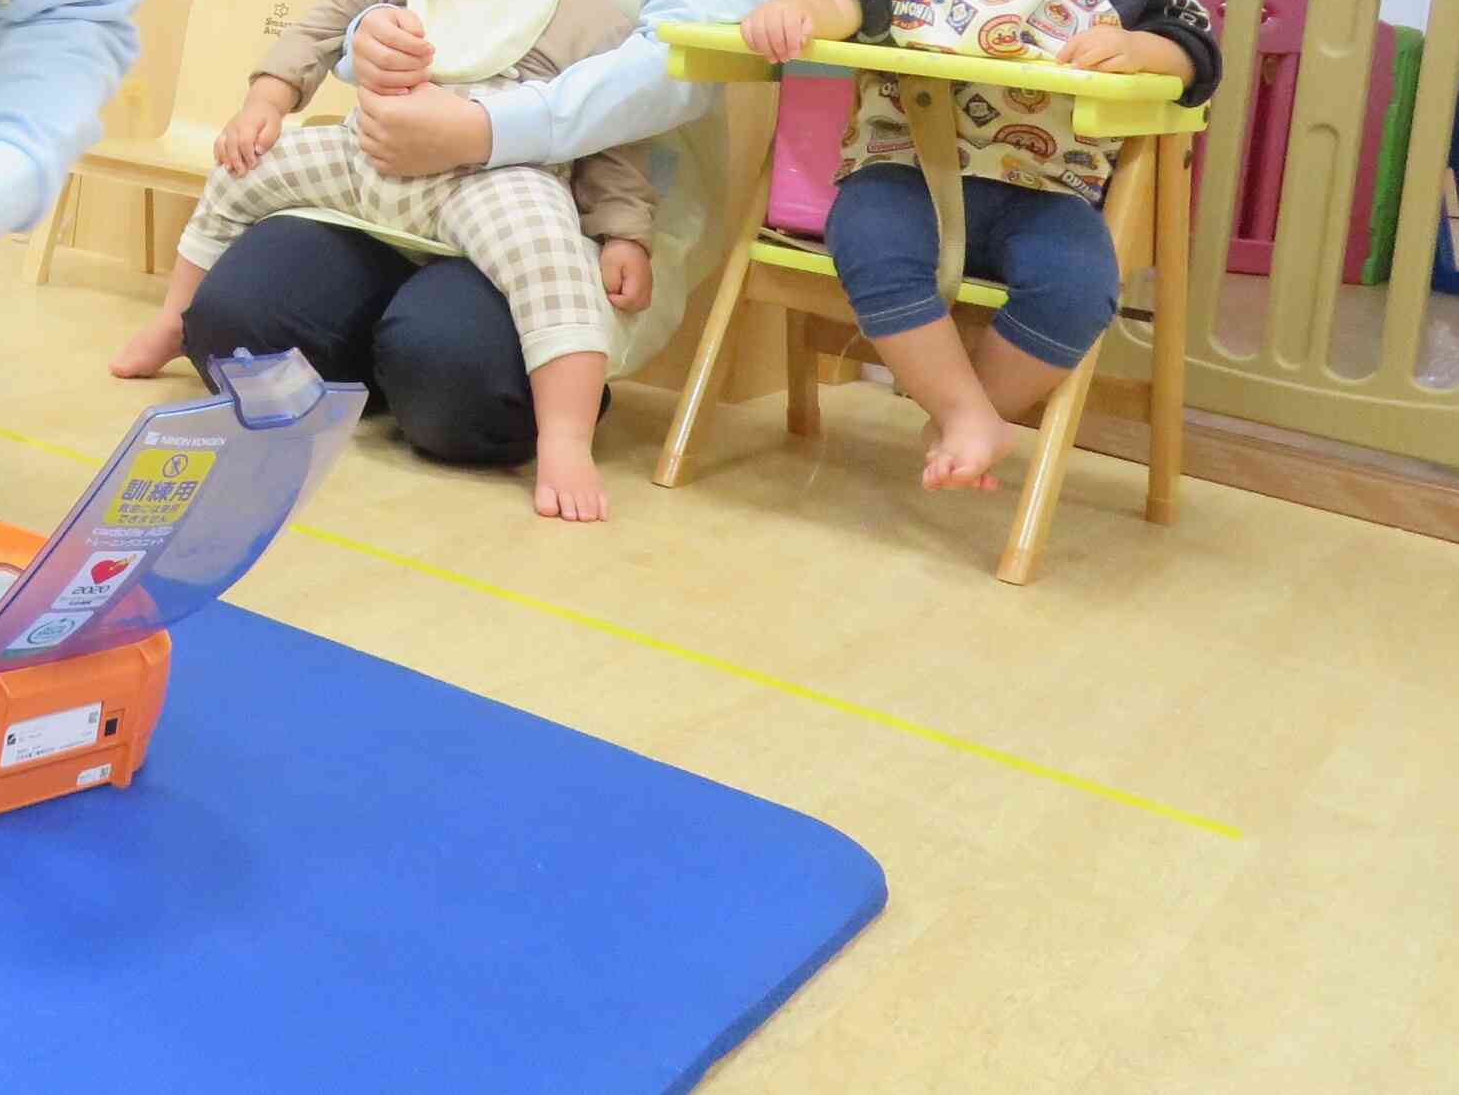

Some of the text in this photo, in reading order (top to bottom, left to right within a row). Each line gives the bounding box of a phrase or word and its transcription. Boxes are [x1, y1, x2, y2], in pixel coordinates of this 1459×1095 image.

[123, 480, 198, 502] 訓練用
[71, 585, 111, 595] 2020
